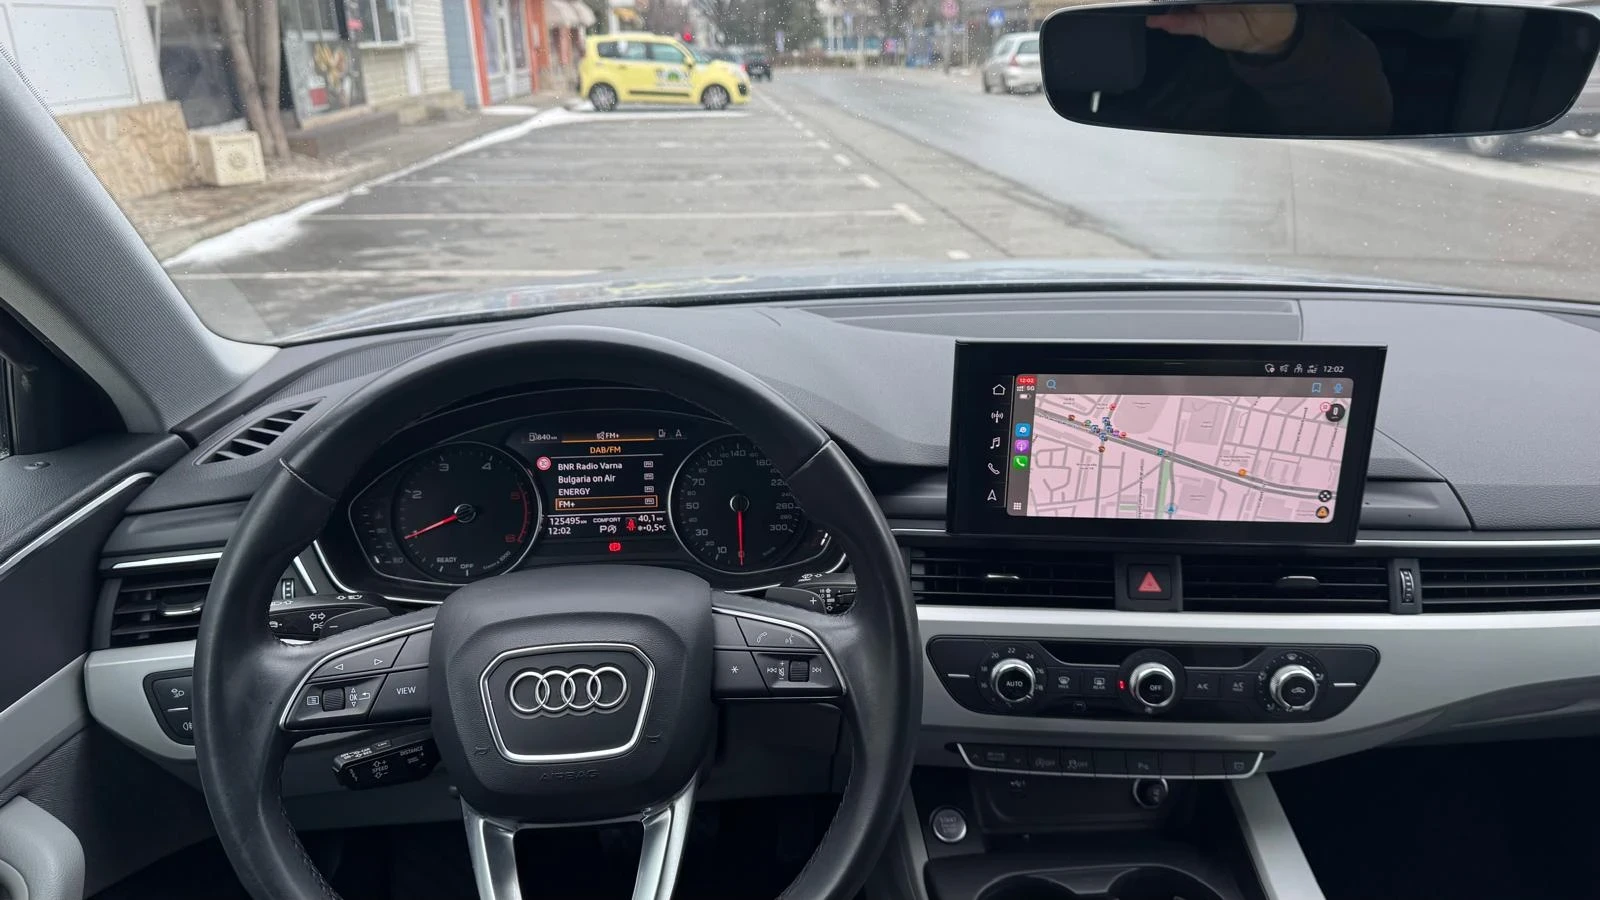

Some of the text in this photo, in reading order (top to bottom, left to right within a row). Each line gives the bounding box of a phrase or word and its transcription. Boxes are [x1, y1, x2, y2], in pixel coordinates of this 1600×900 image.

[1323, 365, 1345, 373] 12:02
[590, 446, 622, 454] DAB/FM
[439, 463, 449, 472] 3
[482, 463, 492, 471] 4
[558, 463, 575, 471] BNR
[576, 462, 598, 470] Radio
[558, 475, 591, 485] Bulgaria
[603, 474, 616, 482] Air
[691, 478, 705, 486] 70
[411, 490, 423, 499] 2
[558, 487, 591, 496] ENERGY
[558, 500, 576, 508] FM+
[685, 502, 700, 510] 50
[549, 517, 581, 525] 125495
[638, 514, 656, 522] 40,1
[548, 527, 571, 535] 12:02
[695, 528, 709, 536] 30
[717, 546, 728, 554] 10
[1006, 680, 1024, 688] AUTO
[396, 686, 417, 695] VIEW
[350, 693, 358, 701] OK
[371, 764, 389, 774] SPEED
